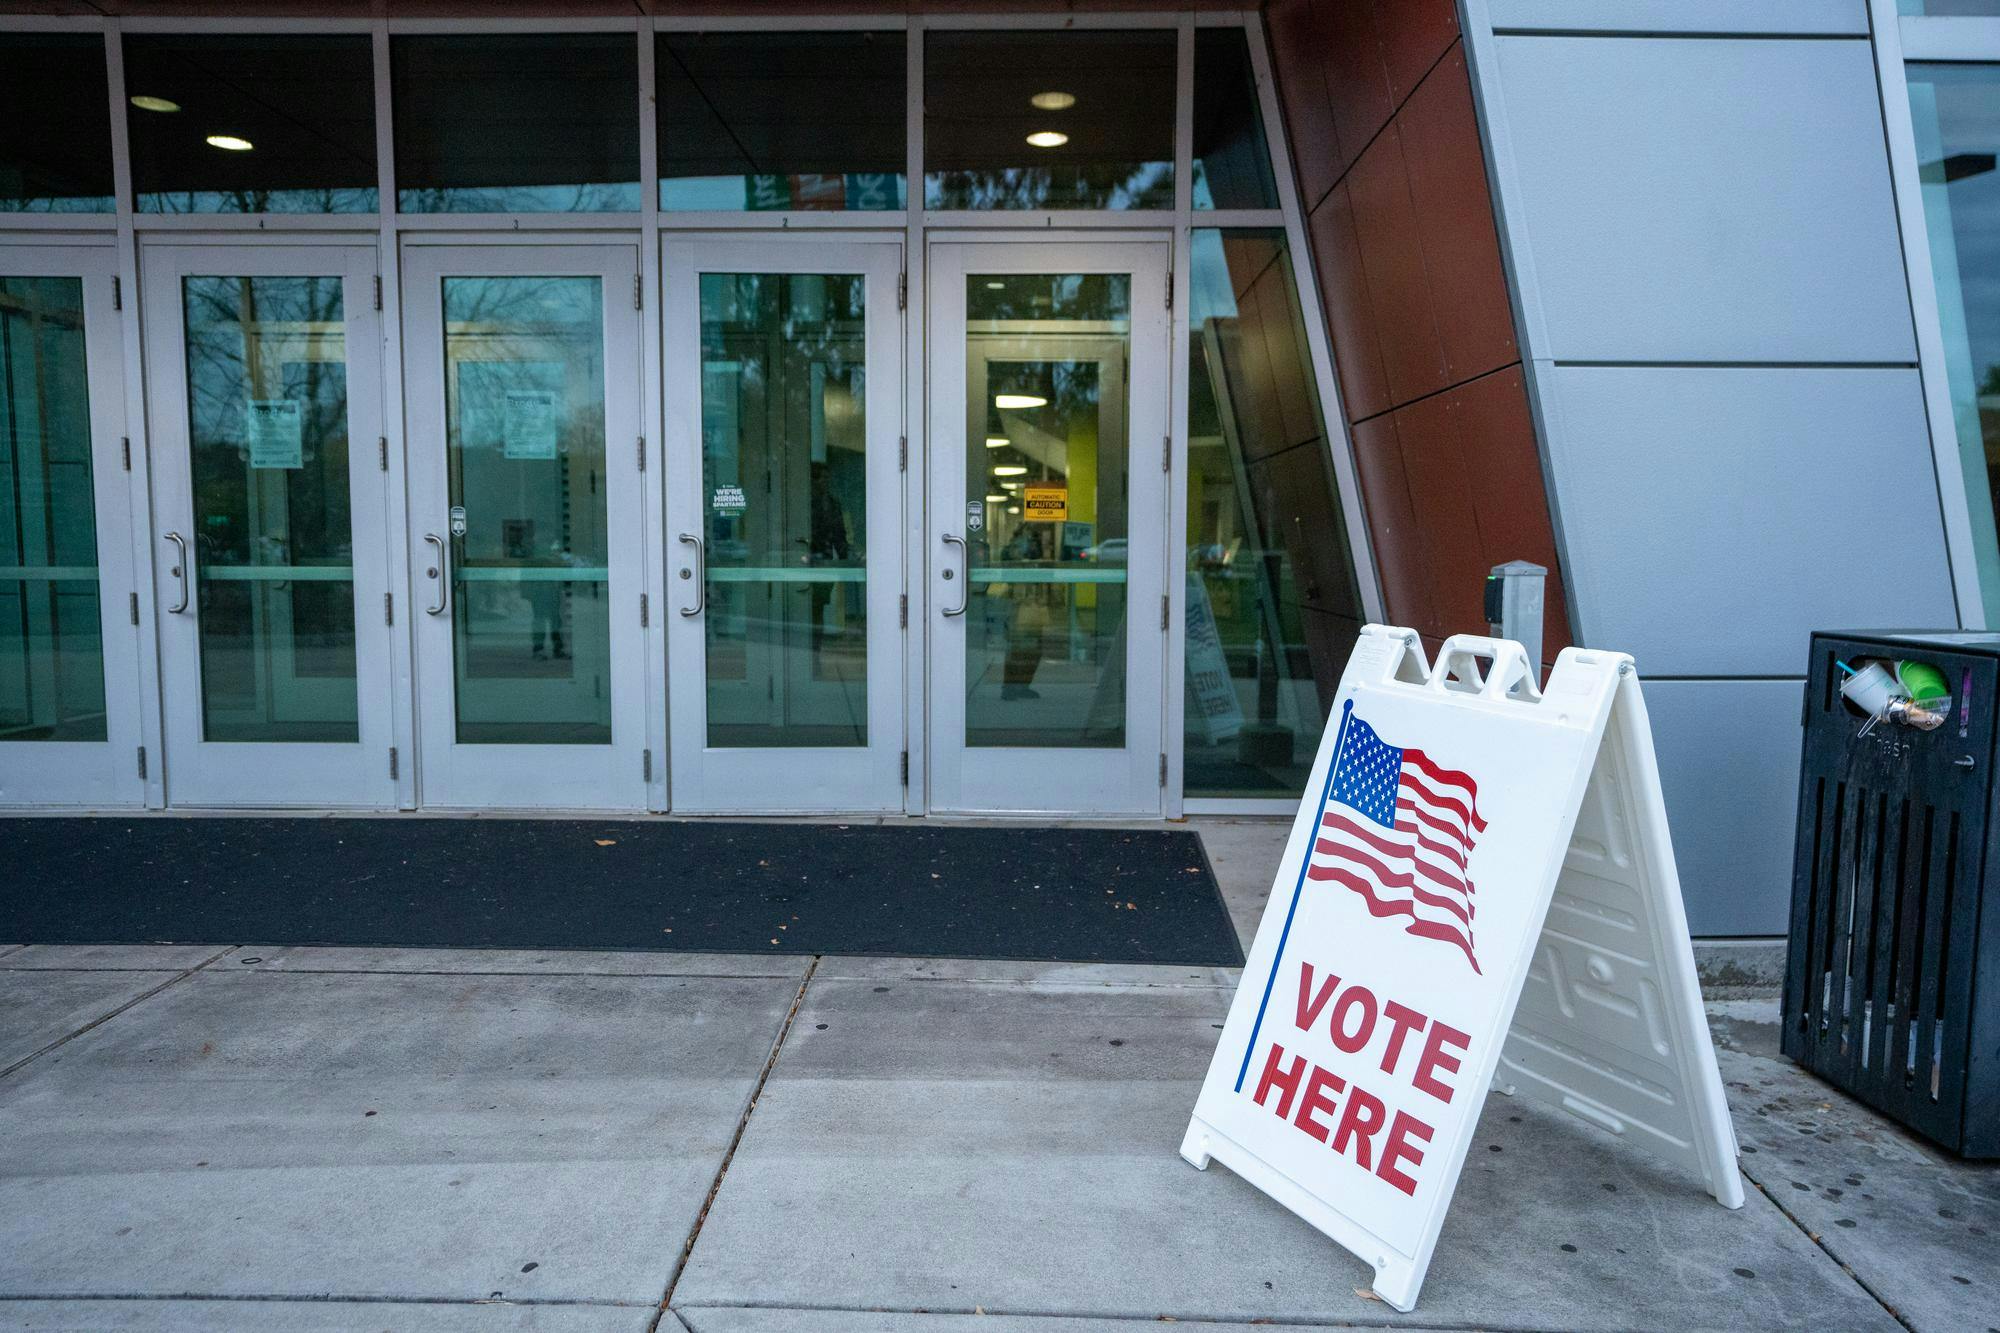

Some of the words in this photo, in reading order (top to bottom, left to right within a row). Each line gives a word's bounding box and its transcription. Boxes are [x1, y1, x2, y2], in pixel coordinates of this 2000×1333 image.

[713, 495, 745, 503] HIRING
[1295, 961, 1471, 1104] VOTE
[1253, 1042, 1435, 1197] HERE
